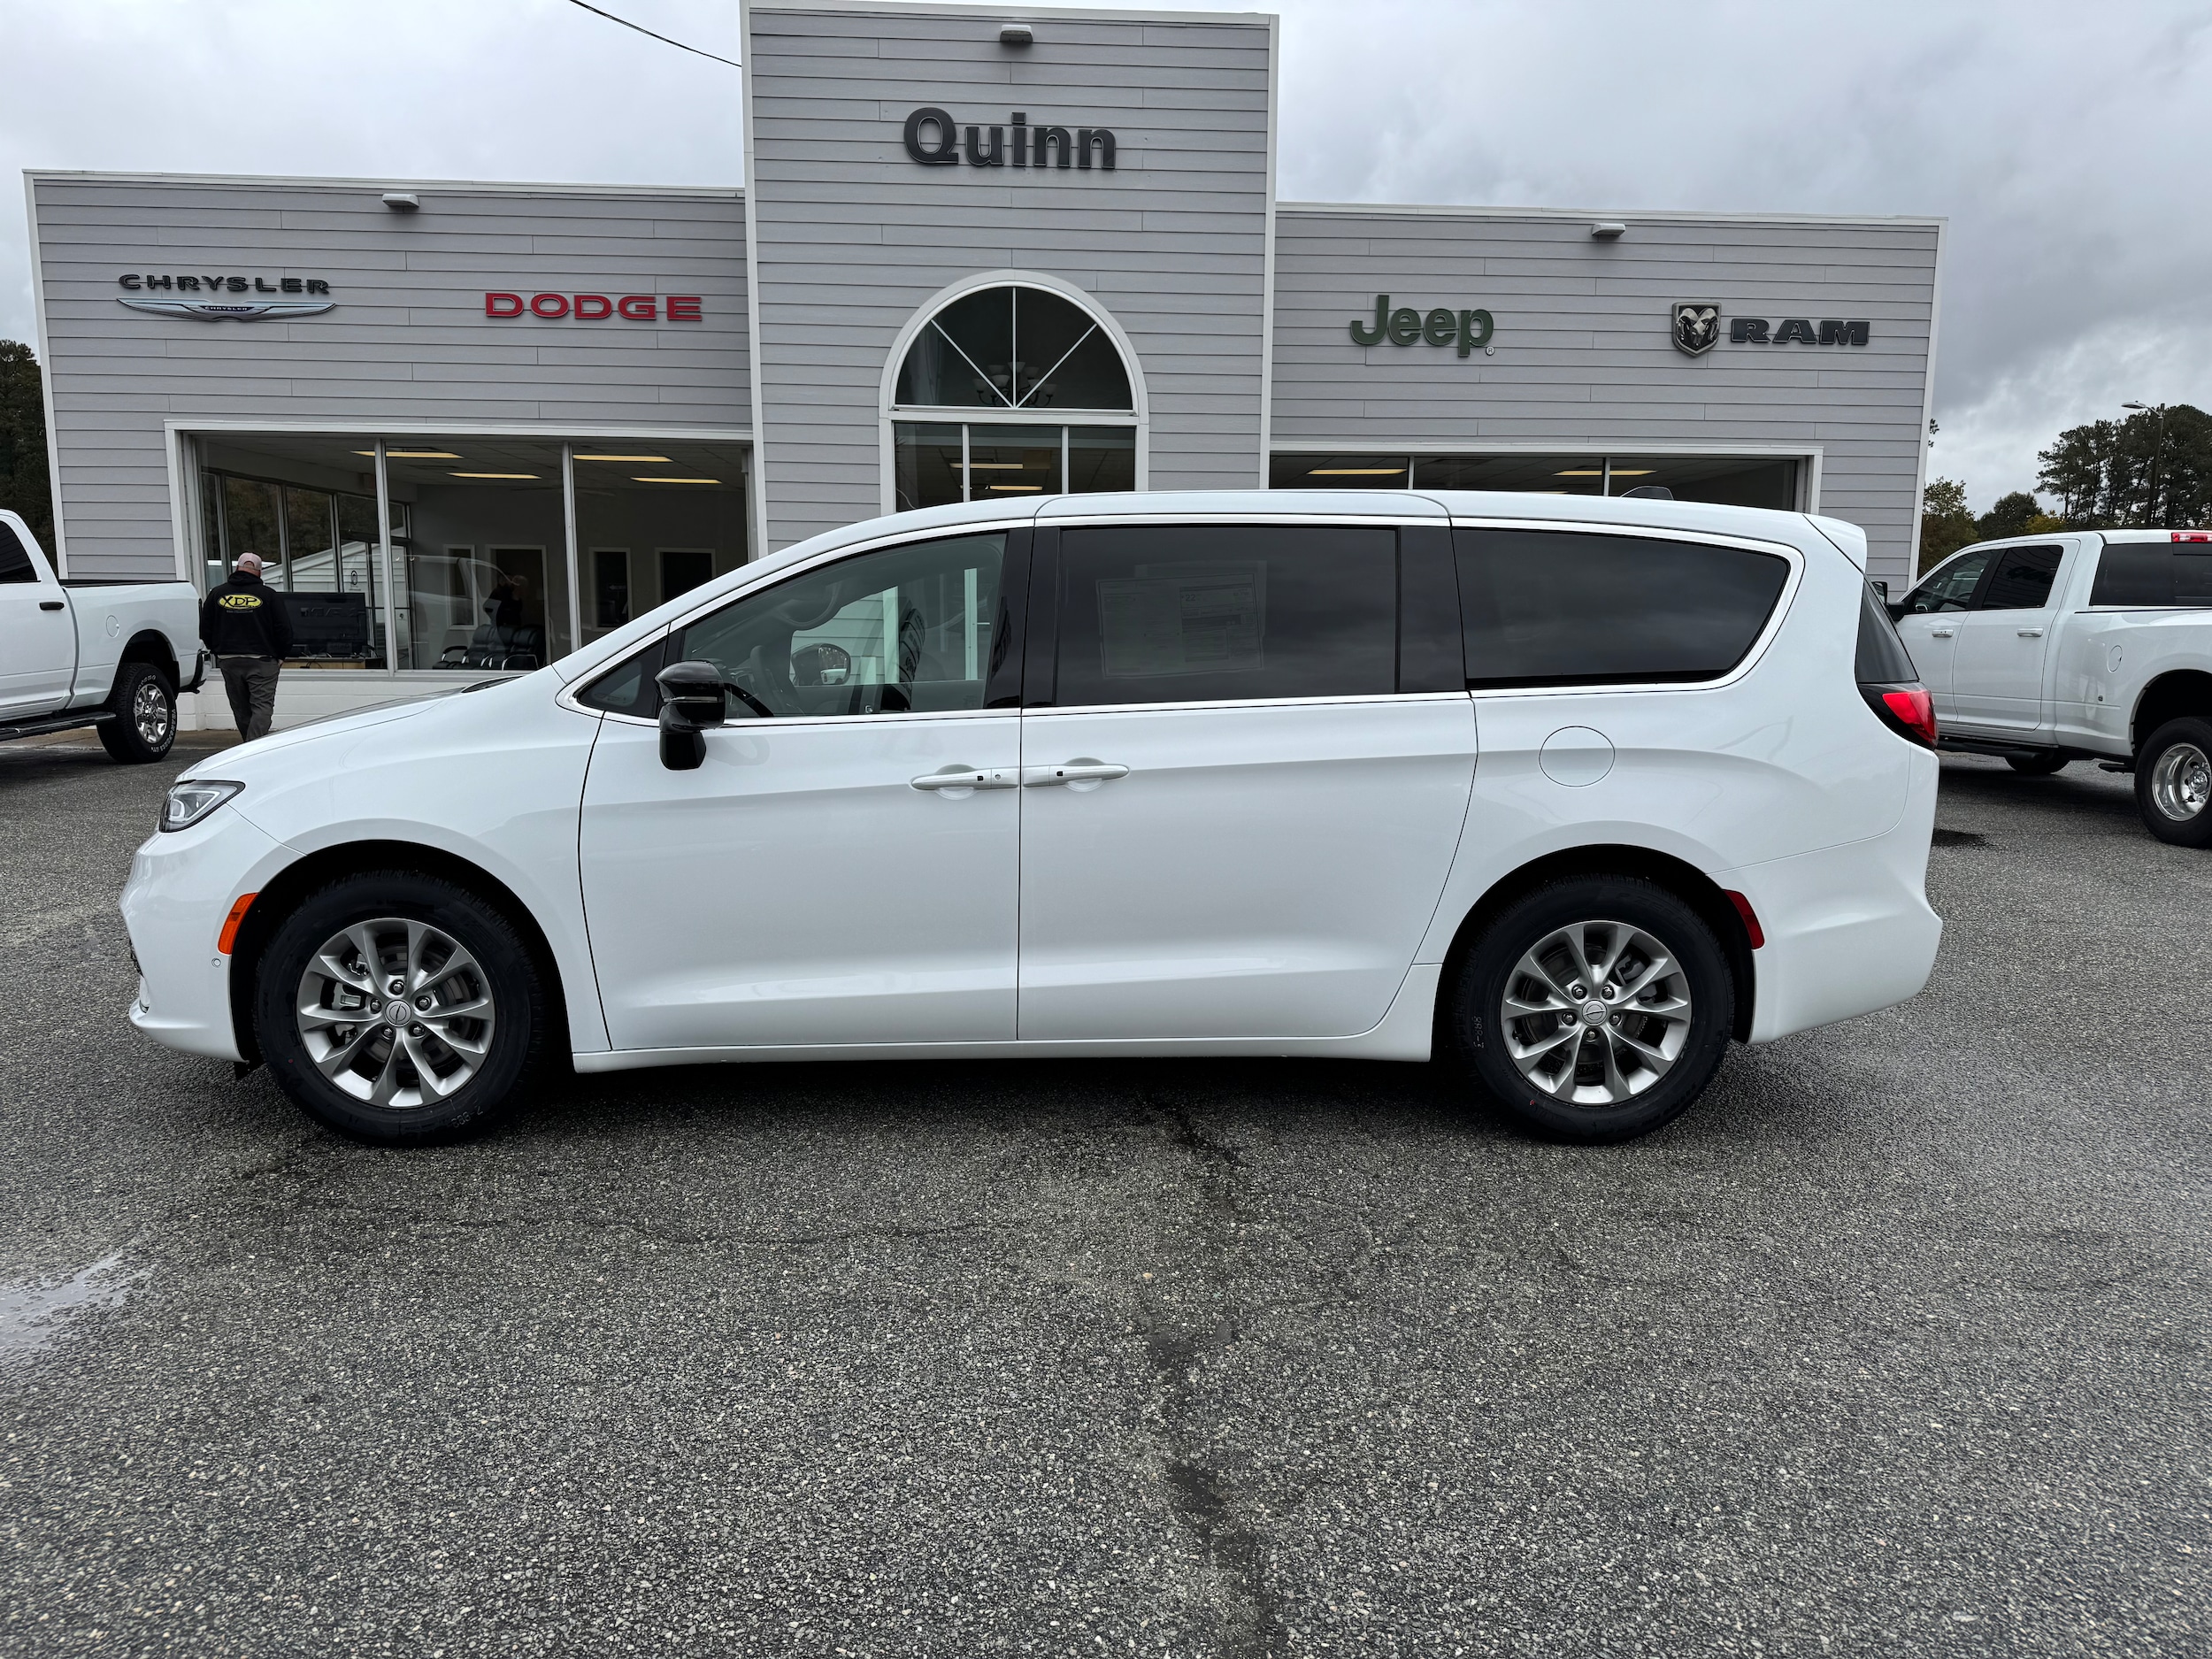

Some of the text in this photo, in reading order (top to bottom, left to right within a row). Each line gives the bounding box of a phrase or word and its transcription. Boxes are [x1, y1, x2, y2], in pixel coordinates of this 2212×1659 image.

[903, 106, 1117, 170] Quinn
[118, 273, 329, 295] CHRYSLER
[485, 292, 703, 321] DODGE
[1350, 295, 1494, 357] Jeep
[1731, 318, 1870, 345] RAM
[221, 595, 258, 608] XDP
